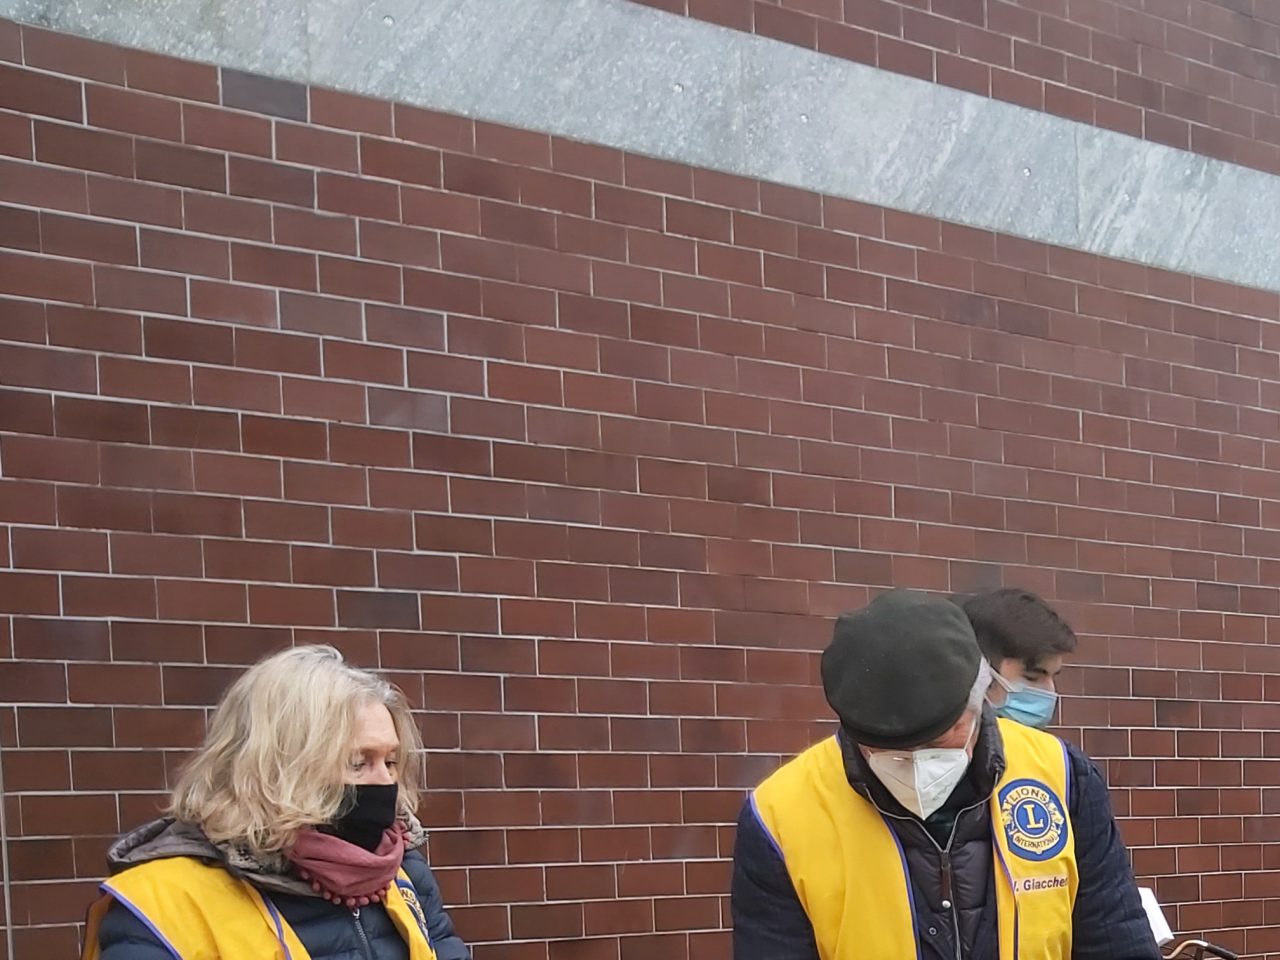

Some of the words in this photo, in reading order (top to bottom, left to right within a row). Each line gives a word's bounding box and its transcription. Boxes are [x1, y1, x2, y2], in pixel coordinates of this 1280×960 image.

[1008, 787, 1048, 802] LIONS
[1023, 804, 1044, 829] L
[1014, 832, 1058, 849] INTERNATIONAL
